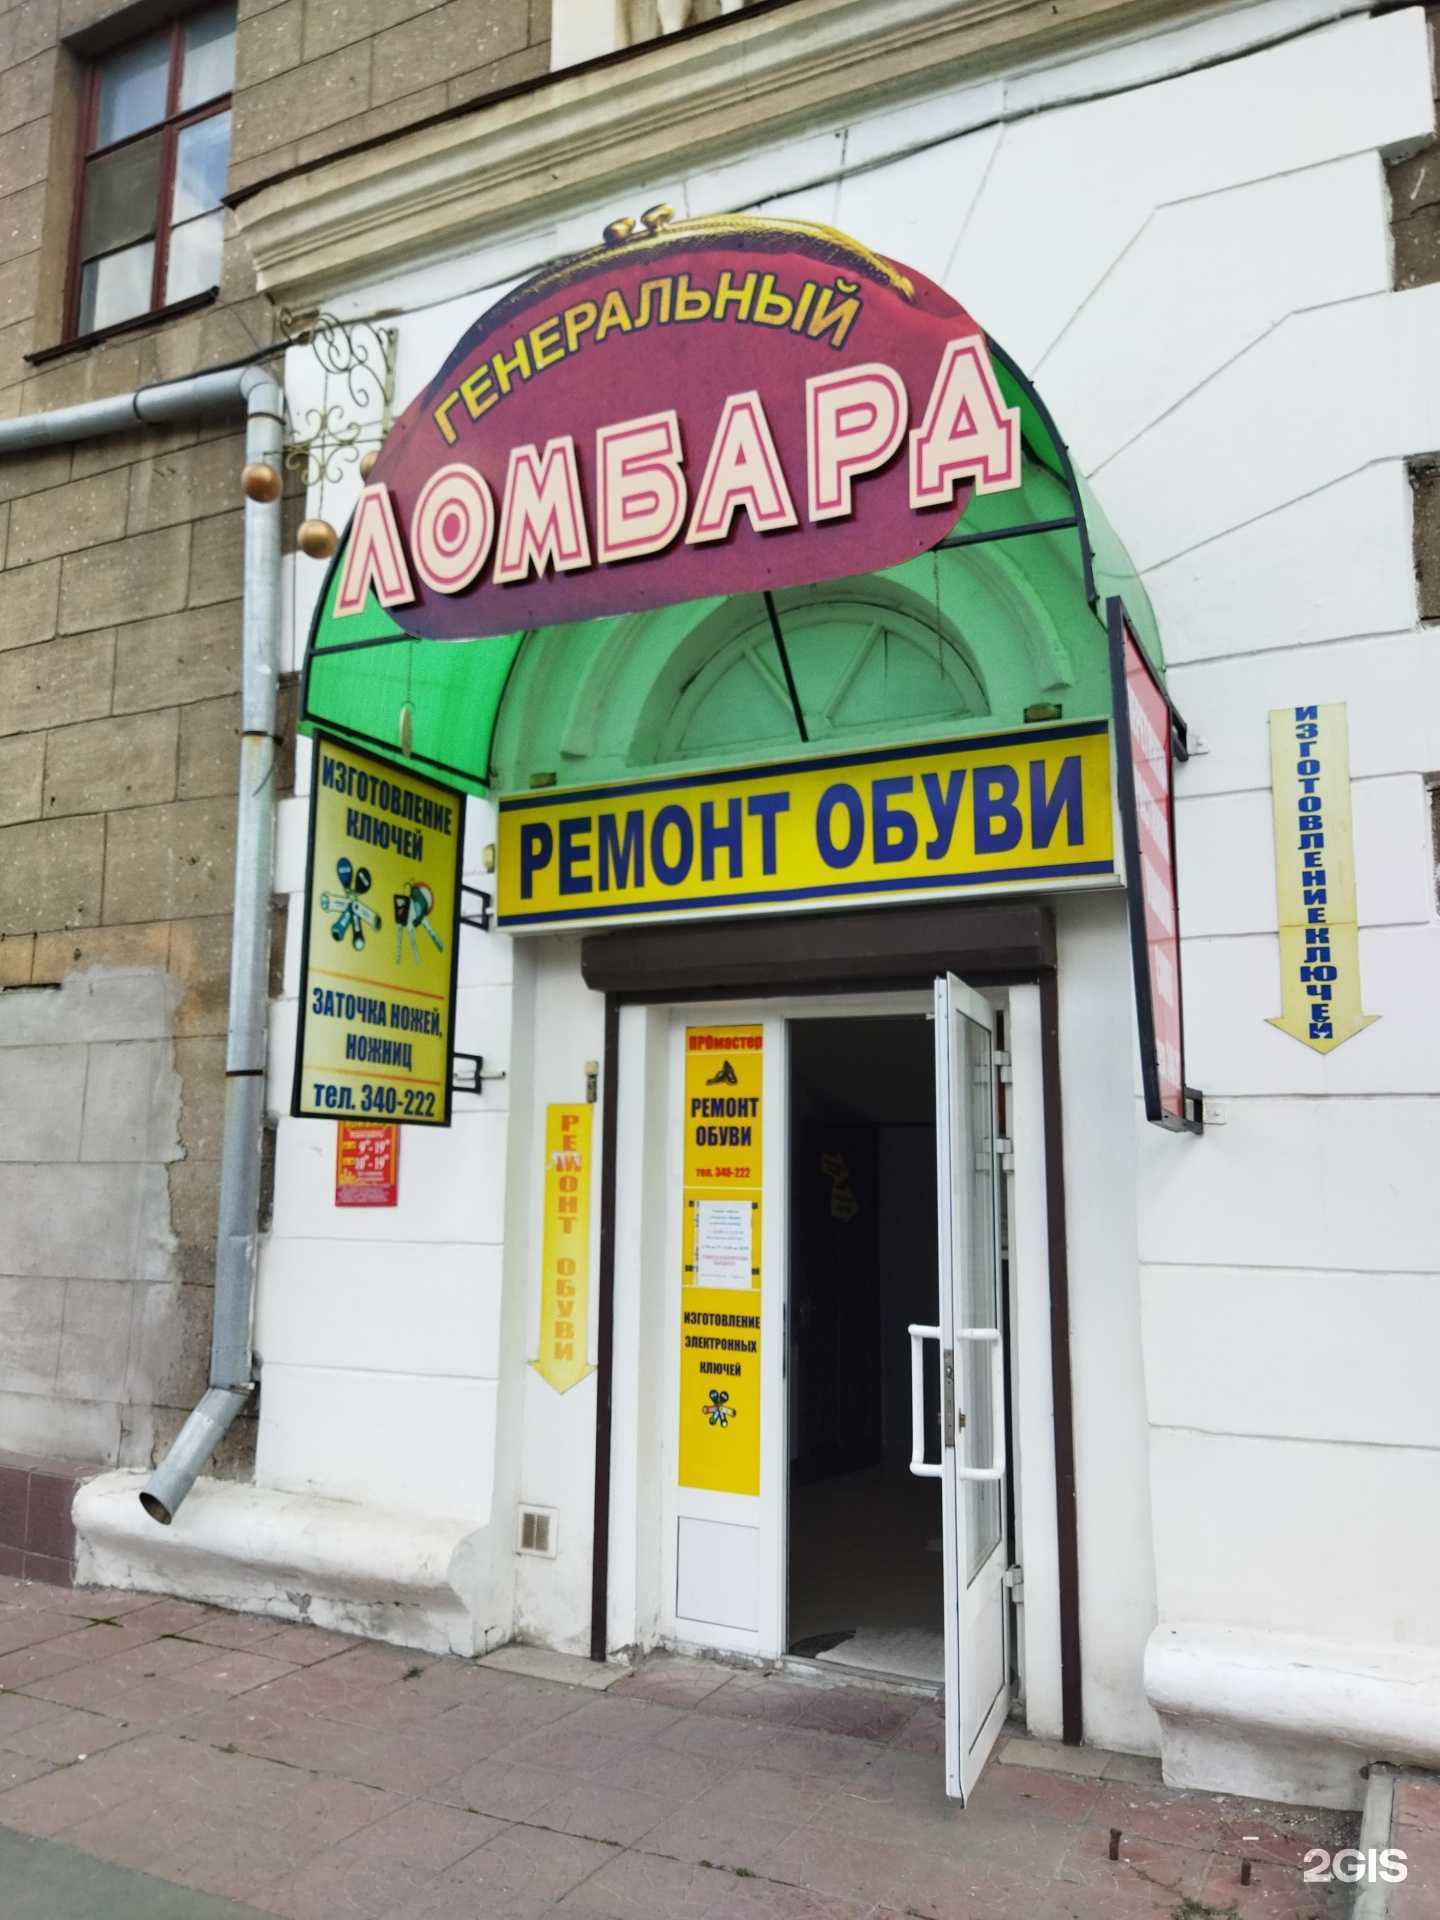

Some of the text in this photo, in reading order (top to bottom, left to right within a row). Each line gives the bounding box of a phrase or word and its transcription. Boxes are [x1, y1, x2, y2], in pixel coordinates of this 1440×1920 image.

[432, 270, 863, 446] ГЕНЕРАЛЬНЫЙ
[332, 334, 1021, 618] ЛОМБАРД
[322, 756, 452, 836] ИЗГОТОВЛЕНИЕ
[346, 808, 423, 862] КЛЮЧЕЙ
[520, 755, 1086, 900] РЕМОНТ ОБУВИ
[313, 987, 442, 1038] ЗАТОЧКА НОЖЕЙ,
[345, 1033, 412, 1072] НОЖНИЦ
[313, 1083, 435, 1117] тел. 340-222
[691, 1098, 759, 1118] РЕМОНТ
[696, 1126, 751, 1146] ОБУВИ
[554, 1258, 577, 1361] ОБУВИ
[684, 1312, 760, 1329] ИЗГОТОВЛЕНИЕ
[685, 1336, 757, 1352] ЭЛЕКТРОННЫХ
[699, 1361, 742, 1376] КЛЮЧЕЙ
